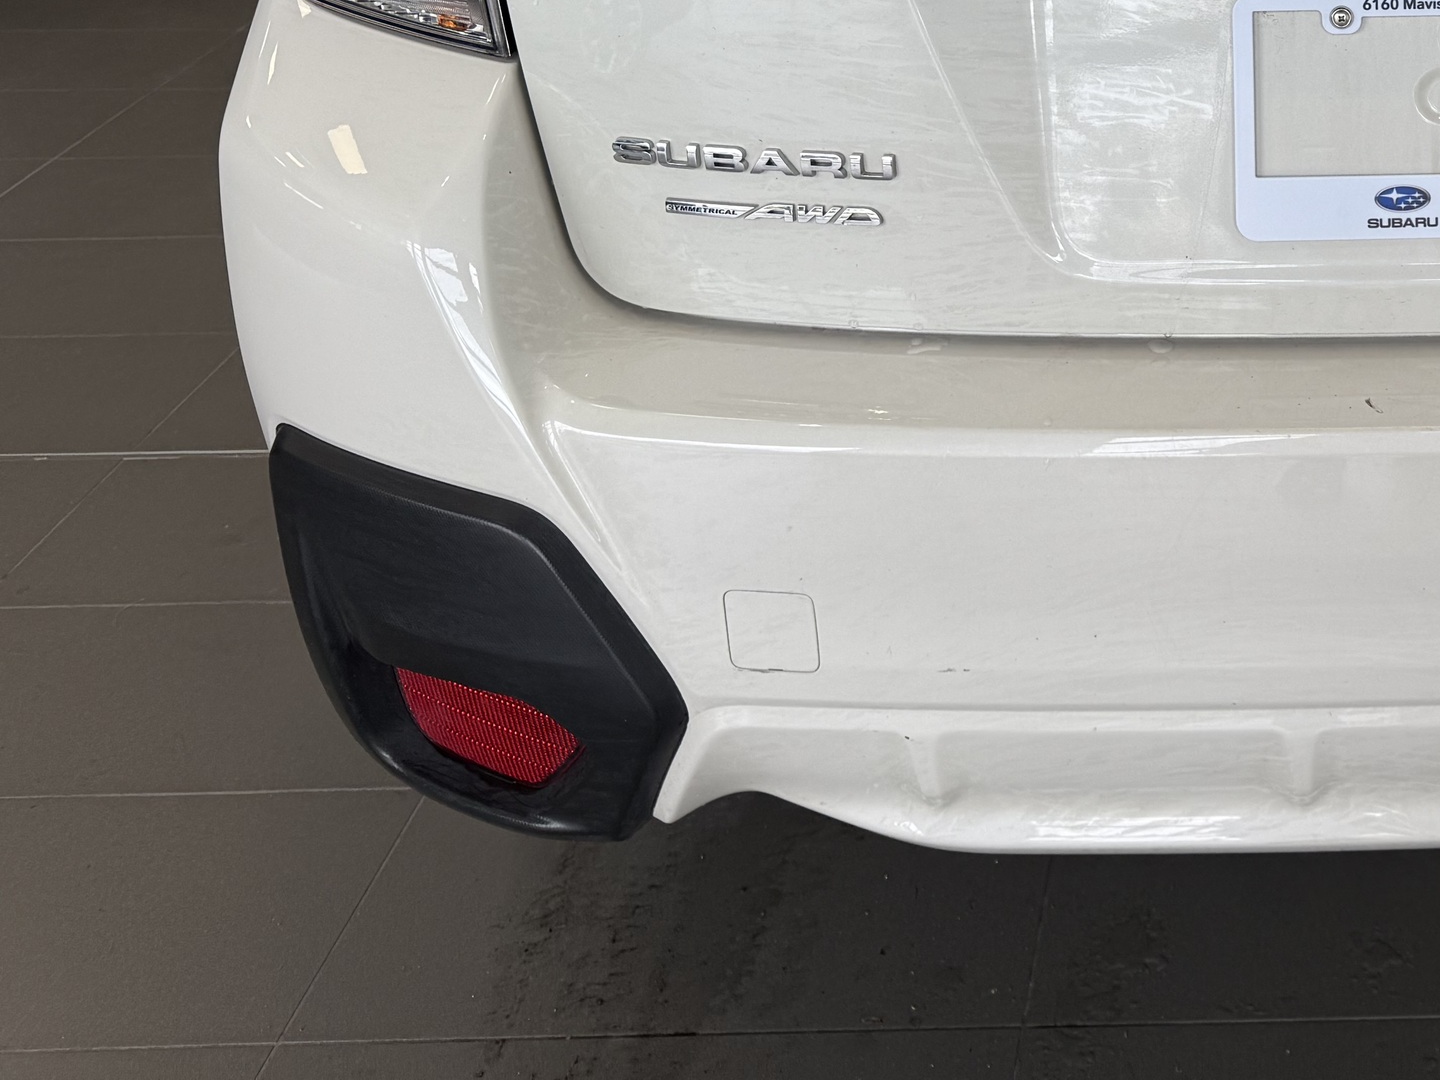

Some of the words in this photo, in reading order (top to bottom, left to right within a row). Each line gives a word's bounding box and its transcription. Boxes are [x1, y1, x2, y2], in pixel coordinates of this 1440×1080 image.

[611, 136, 898, 180] SUBARU
[666, 202, 739, 217] SYMMETRICAL
[745, 203, 884, 227] AWD
[1367, 216, 1439, 229] SUBARU
